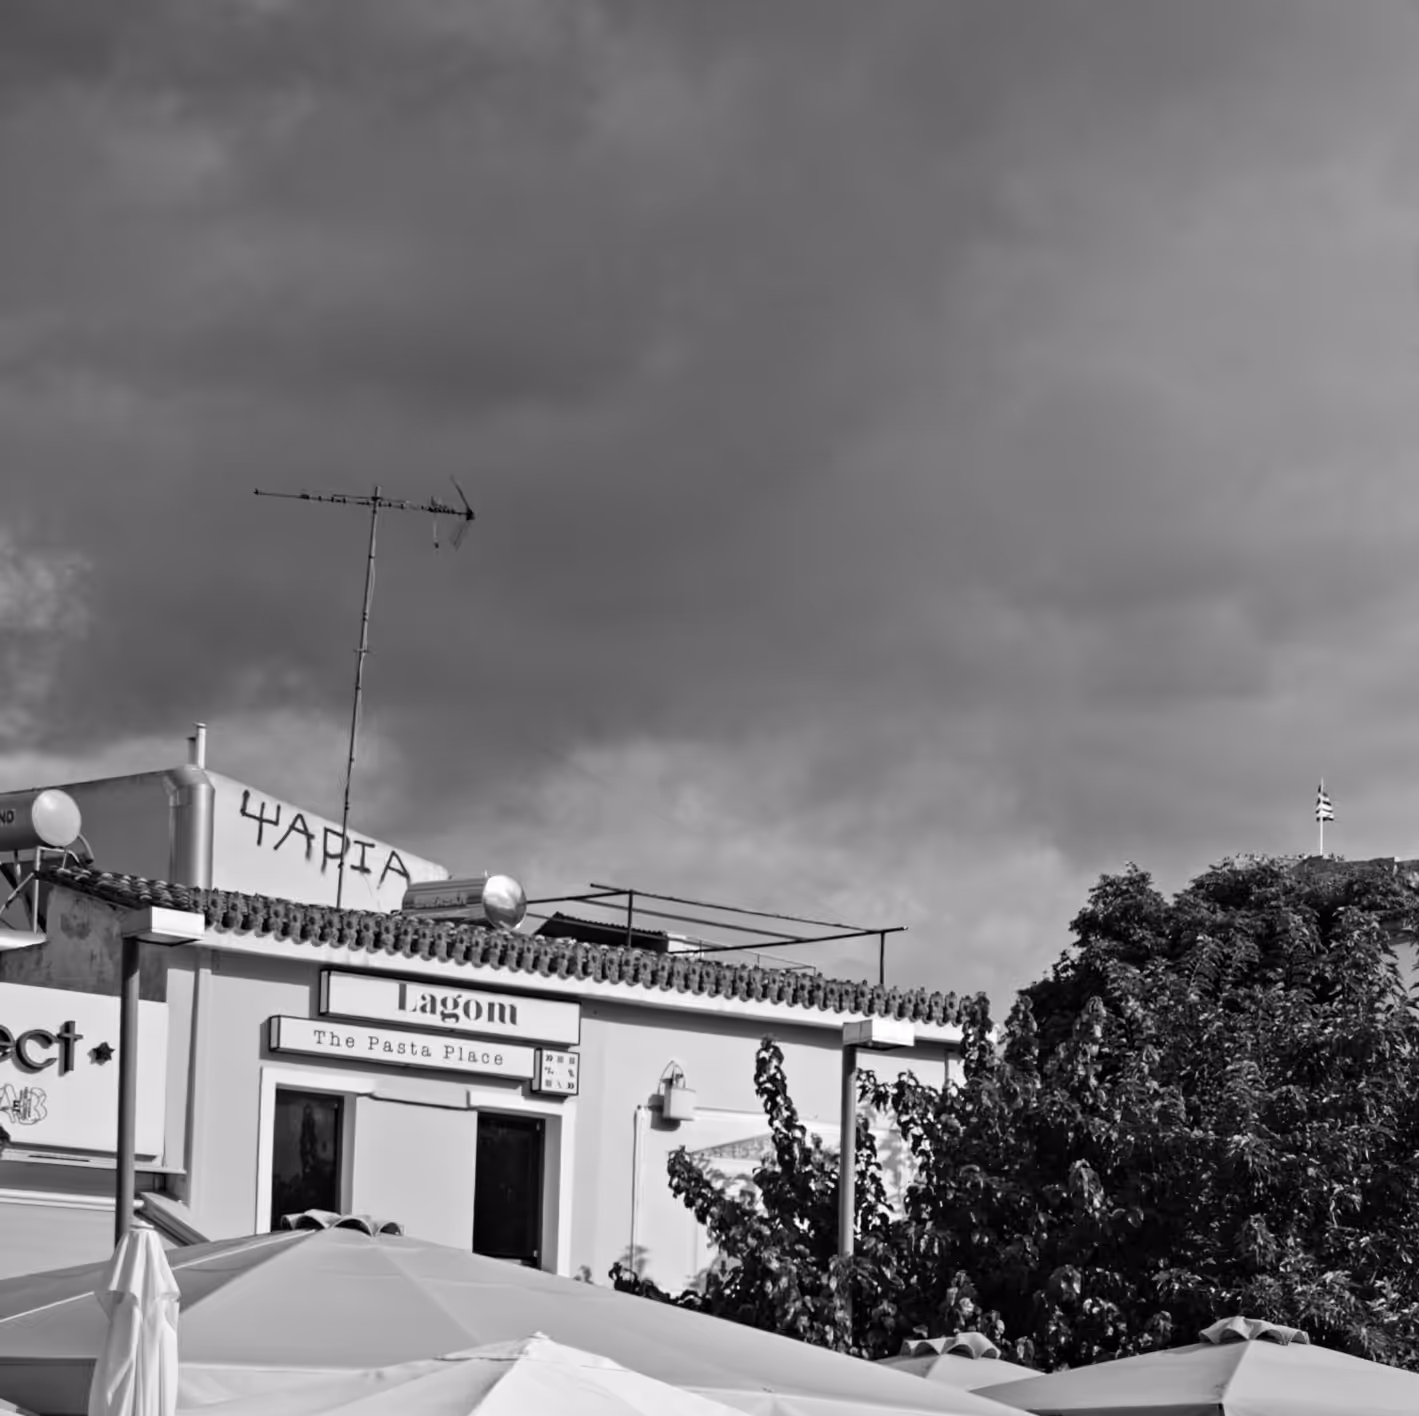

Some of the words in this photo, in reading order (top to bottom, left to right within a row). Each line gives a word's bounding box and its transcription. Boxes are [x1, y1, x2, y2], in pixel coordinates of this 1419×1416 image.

[398, 983, 518, 1025] Lagom
[313, 1029, 355, 1049] The
[367, 1035, 432, 1057] Pasta
[444, 1045, 504, 1066] Place
